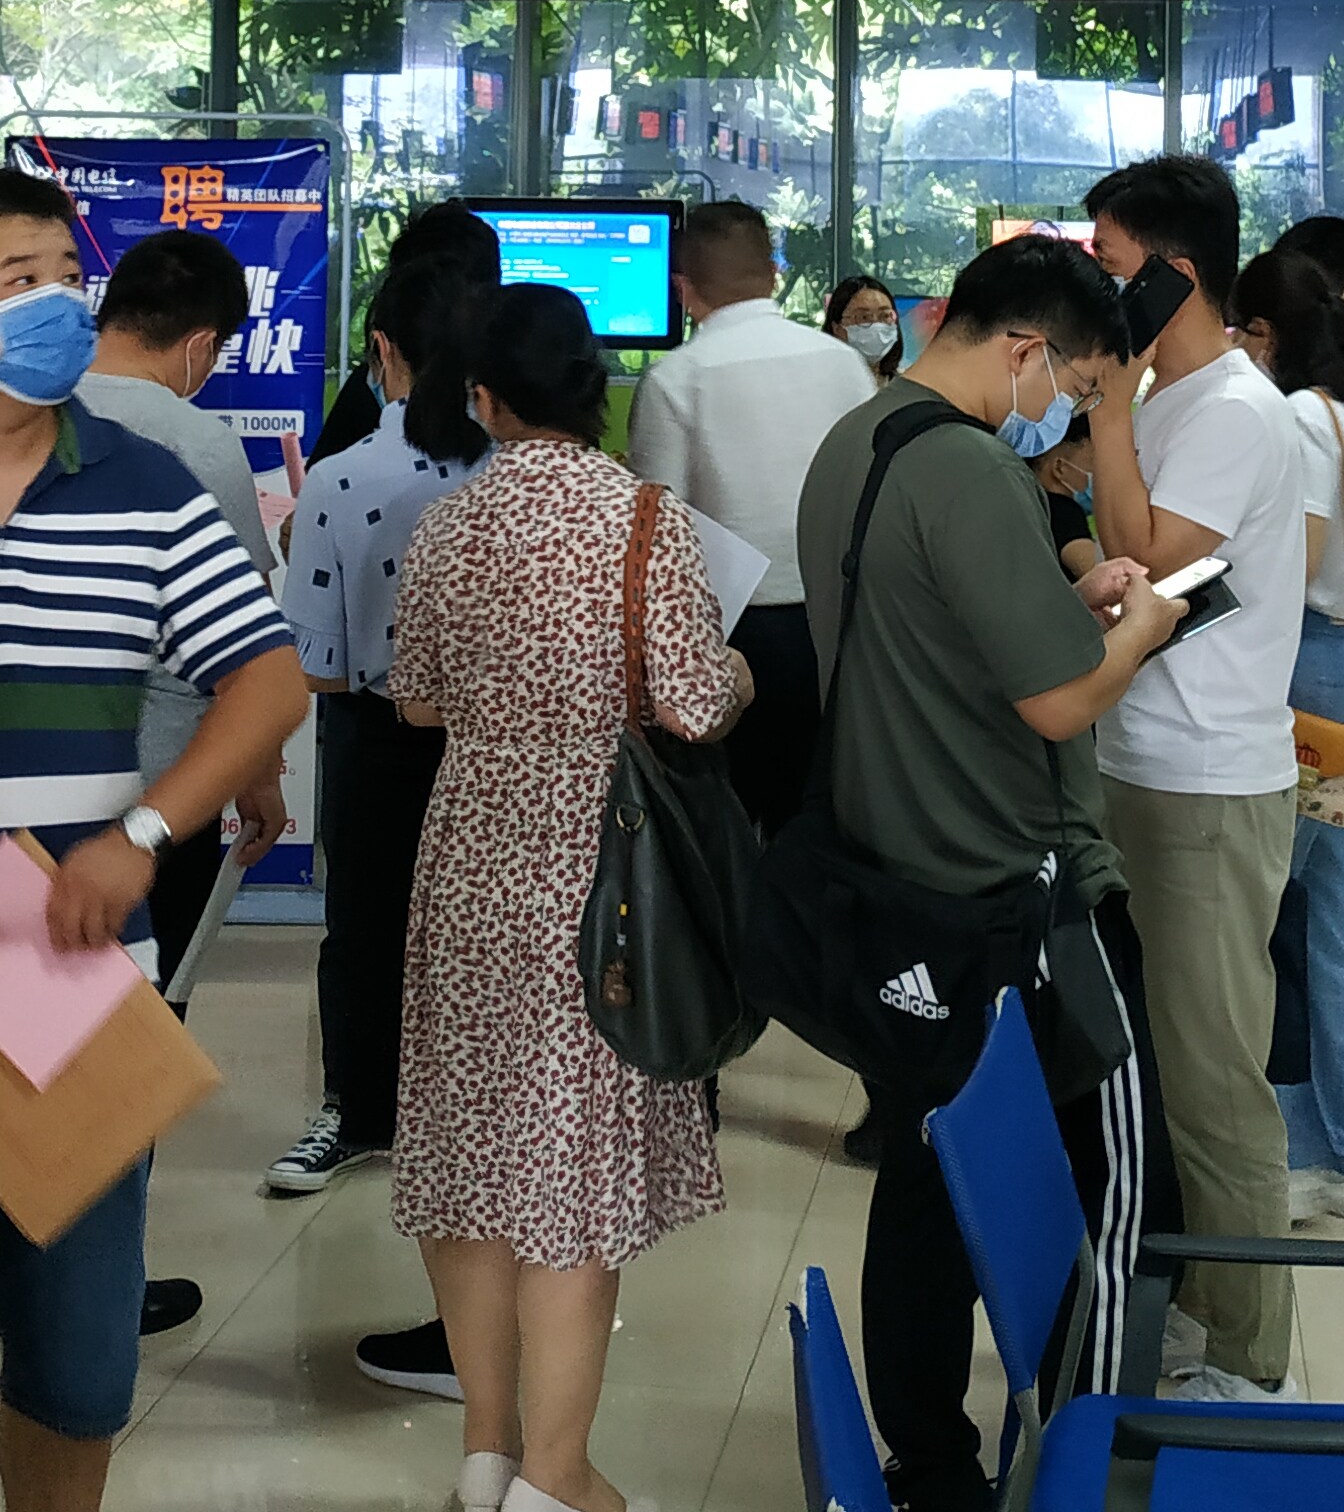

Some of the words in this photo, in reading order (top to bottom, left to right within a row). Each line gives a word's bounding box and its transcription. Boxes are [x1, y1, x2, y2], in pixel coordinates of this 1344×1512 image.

[160, 165, 225, 230] 聘
[242, 416, 297, 431] 1000M
[879, 987, 950, 1020] adidas
